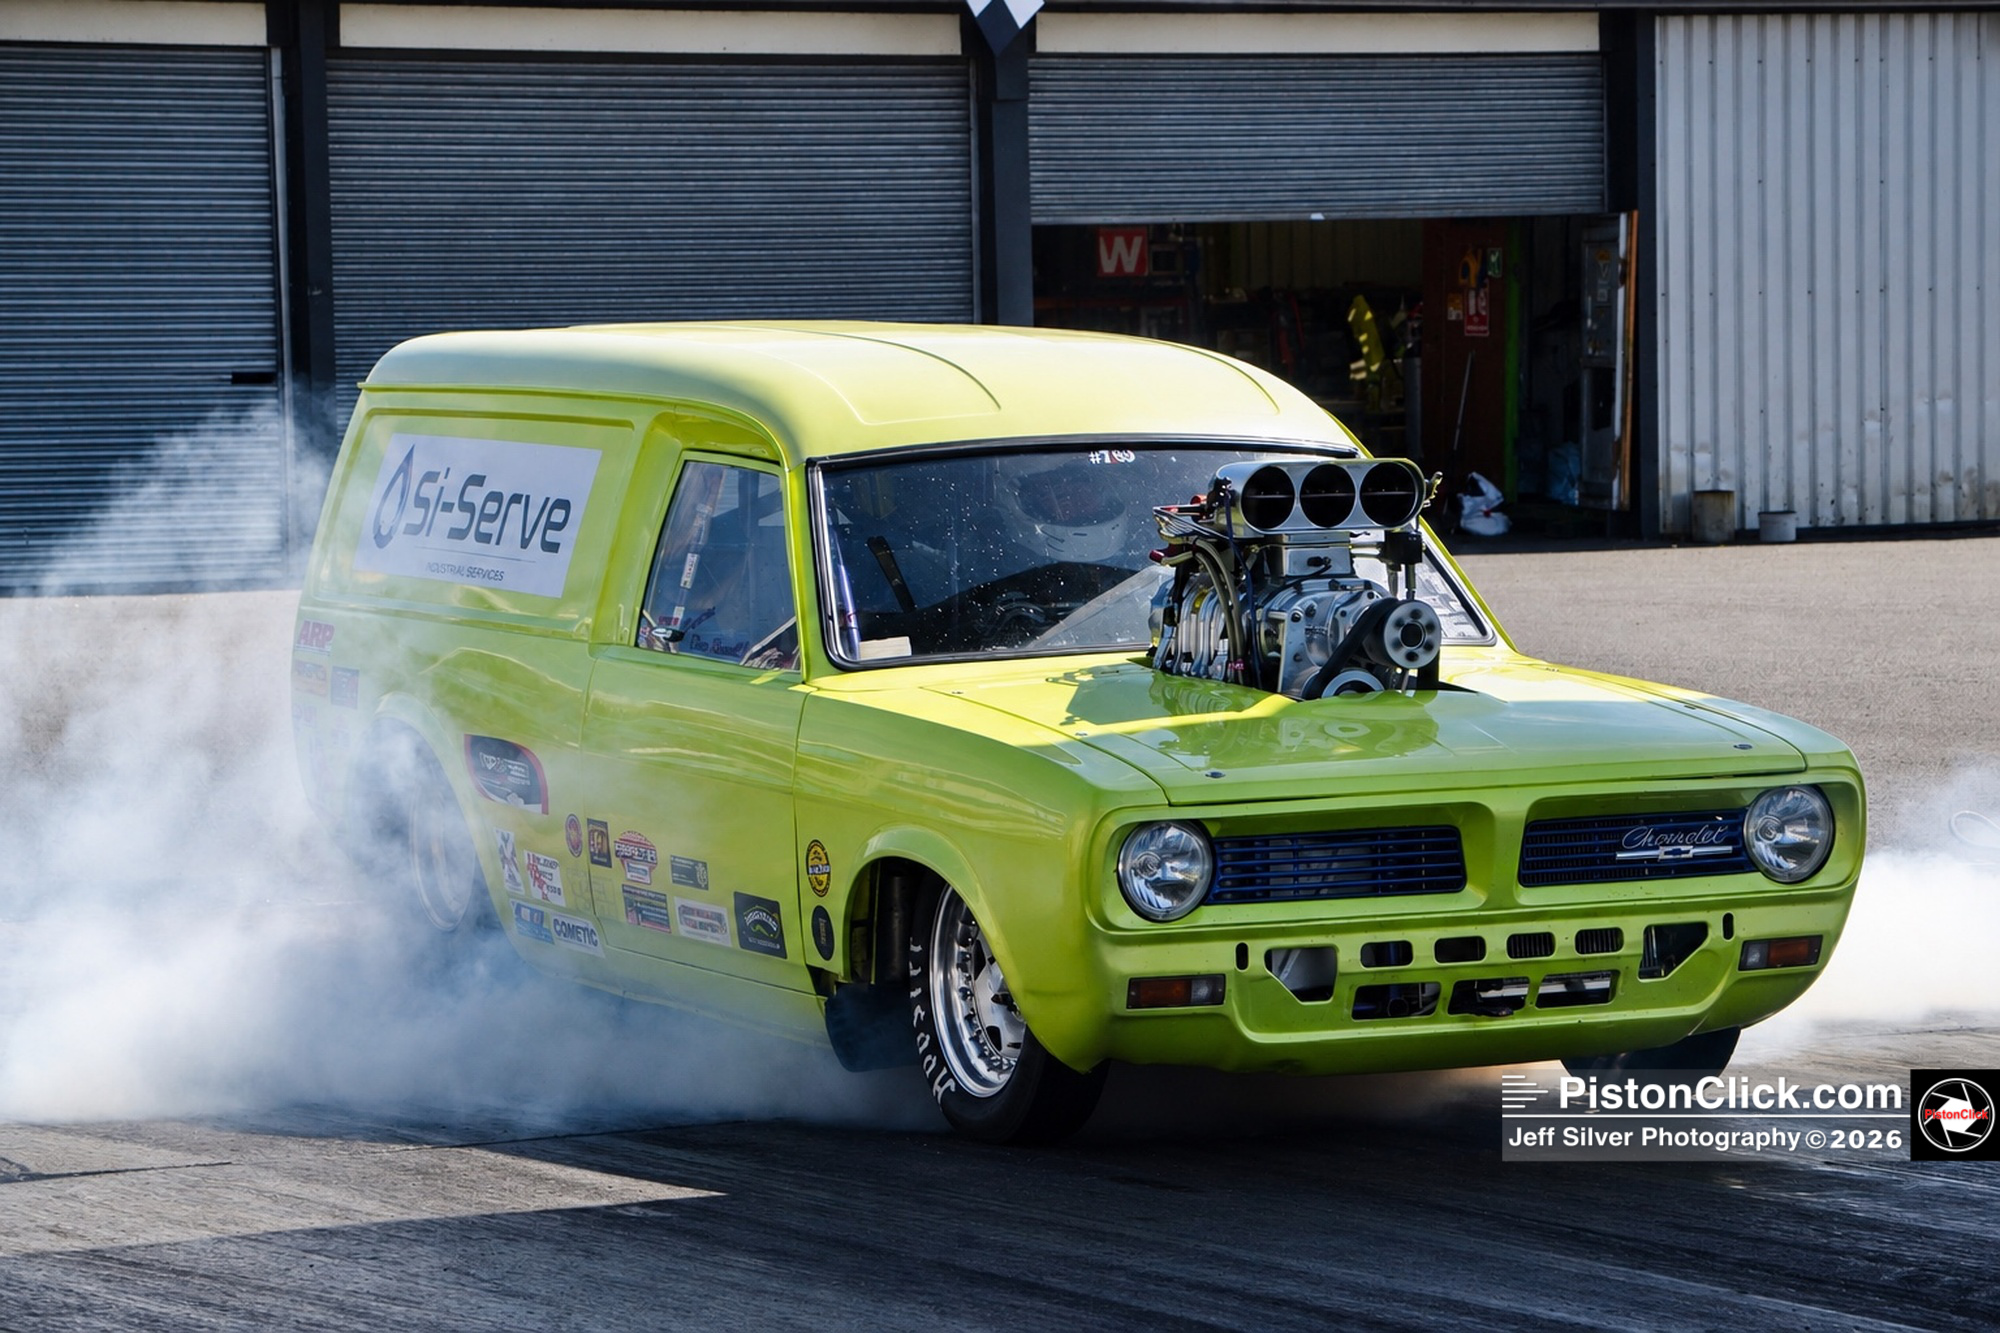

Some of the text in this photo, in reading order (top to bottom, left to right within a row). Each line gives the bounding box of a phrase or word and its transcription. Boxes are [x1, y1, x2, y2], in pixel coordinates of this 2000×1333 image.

[1099, 235, 1143, 273] W
[402, 466, 572, 554] Si-Serve
[465, 565, 504, 582] SERVICES
[297, 619, 335, 650] ARP
[553, 917, 598, 947] COMETIC
